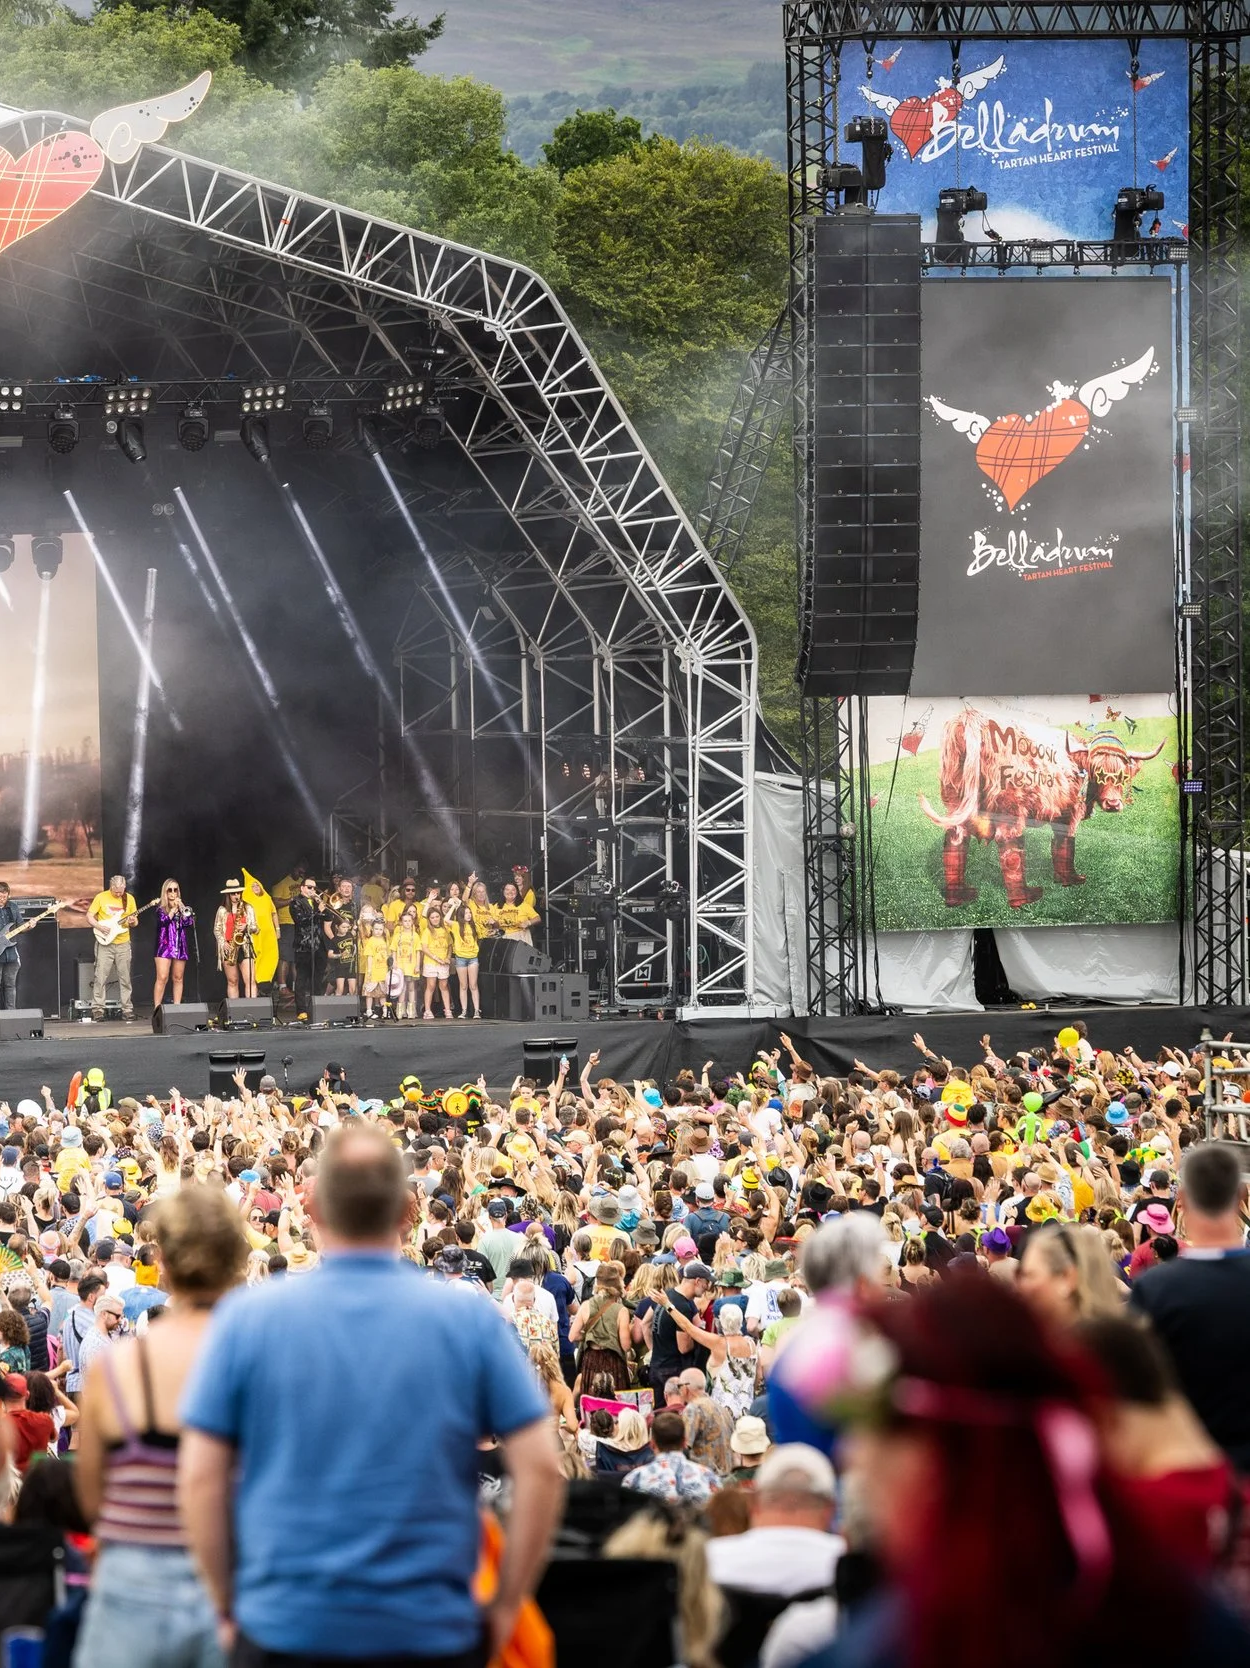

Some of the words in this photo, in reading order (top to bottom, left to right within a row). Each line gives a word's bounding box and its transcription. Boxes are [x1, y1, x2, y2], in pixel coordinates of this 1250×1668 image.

[921, 97, 1120, 163] Belladrum
[998, 155, 1038, 170] TARTAN
[1039, 150, 1073, 164] HEART
[1075, 143, 1120, 158] FESTIVAL
[966, 528, 1113, 577] Belladrum
[1023, 571, 1052, 581] TARTAN
[1053, 566, 1078, 577] HEART
[1079, 561, 1113, 572] FESTIVAL
[1000, 765, 1055, 790] Festival
